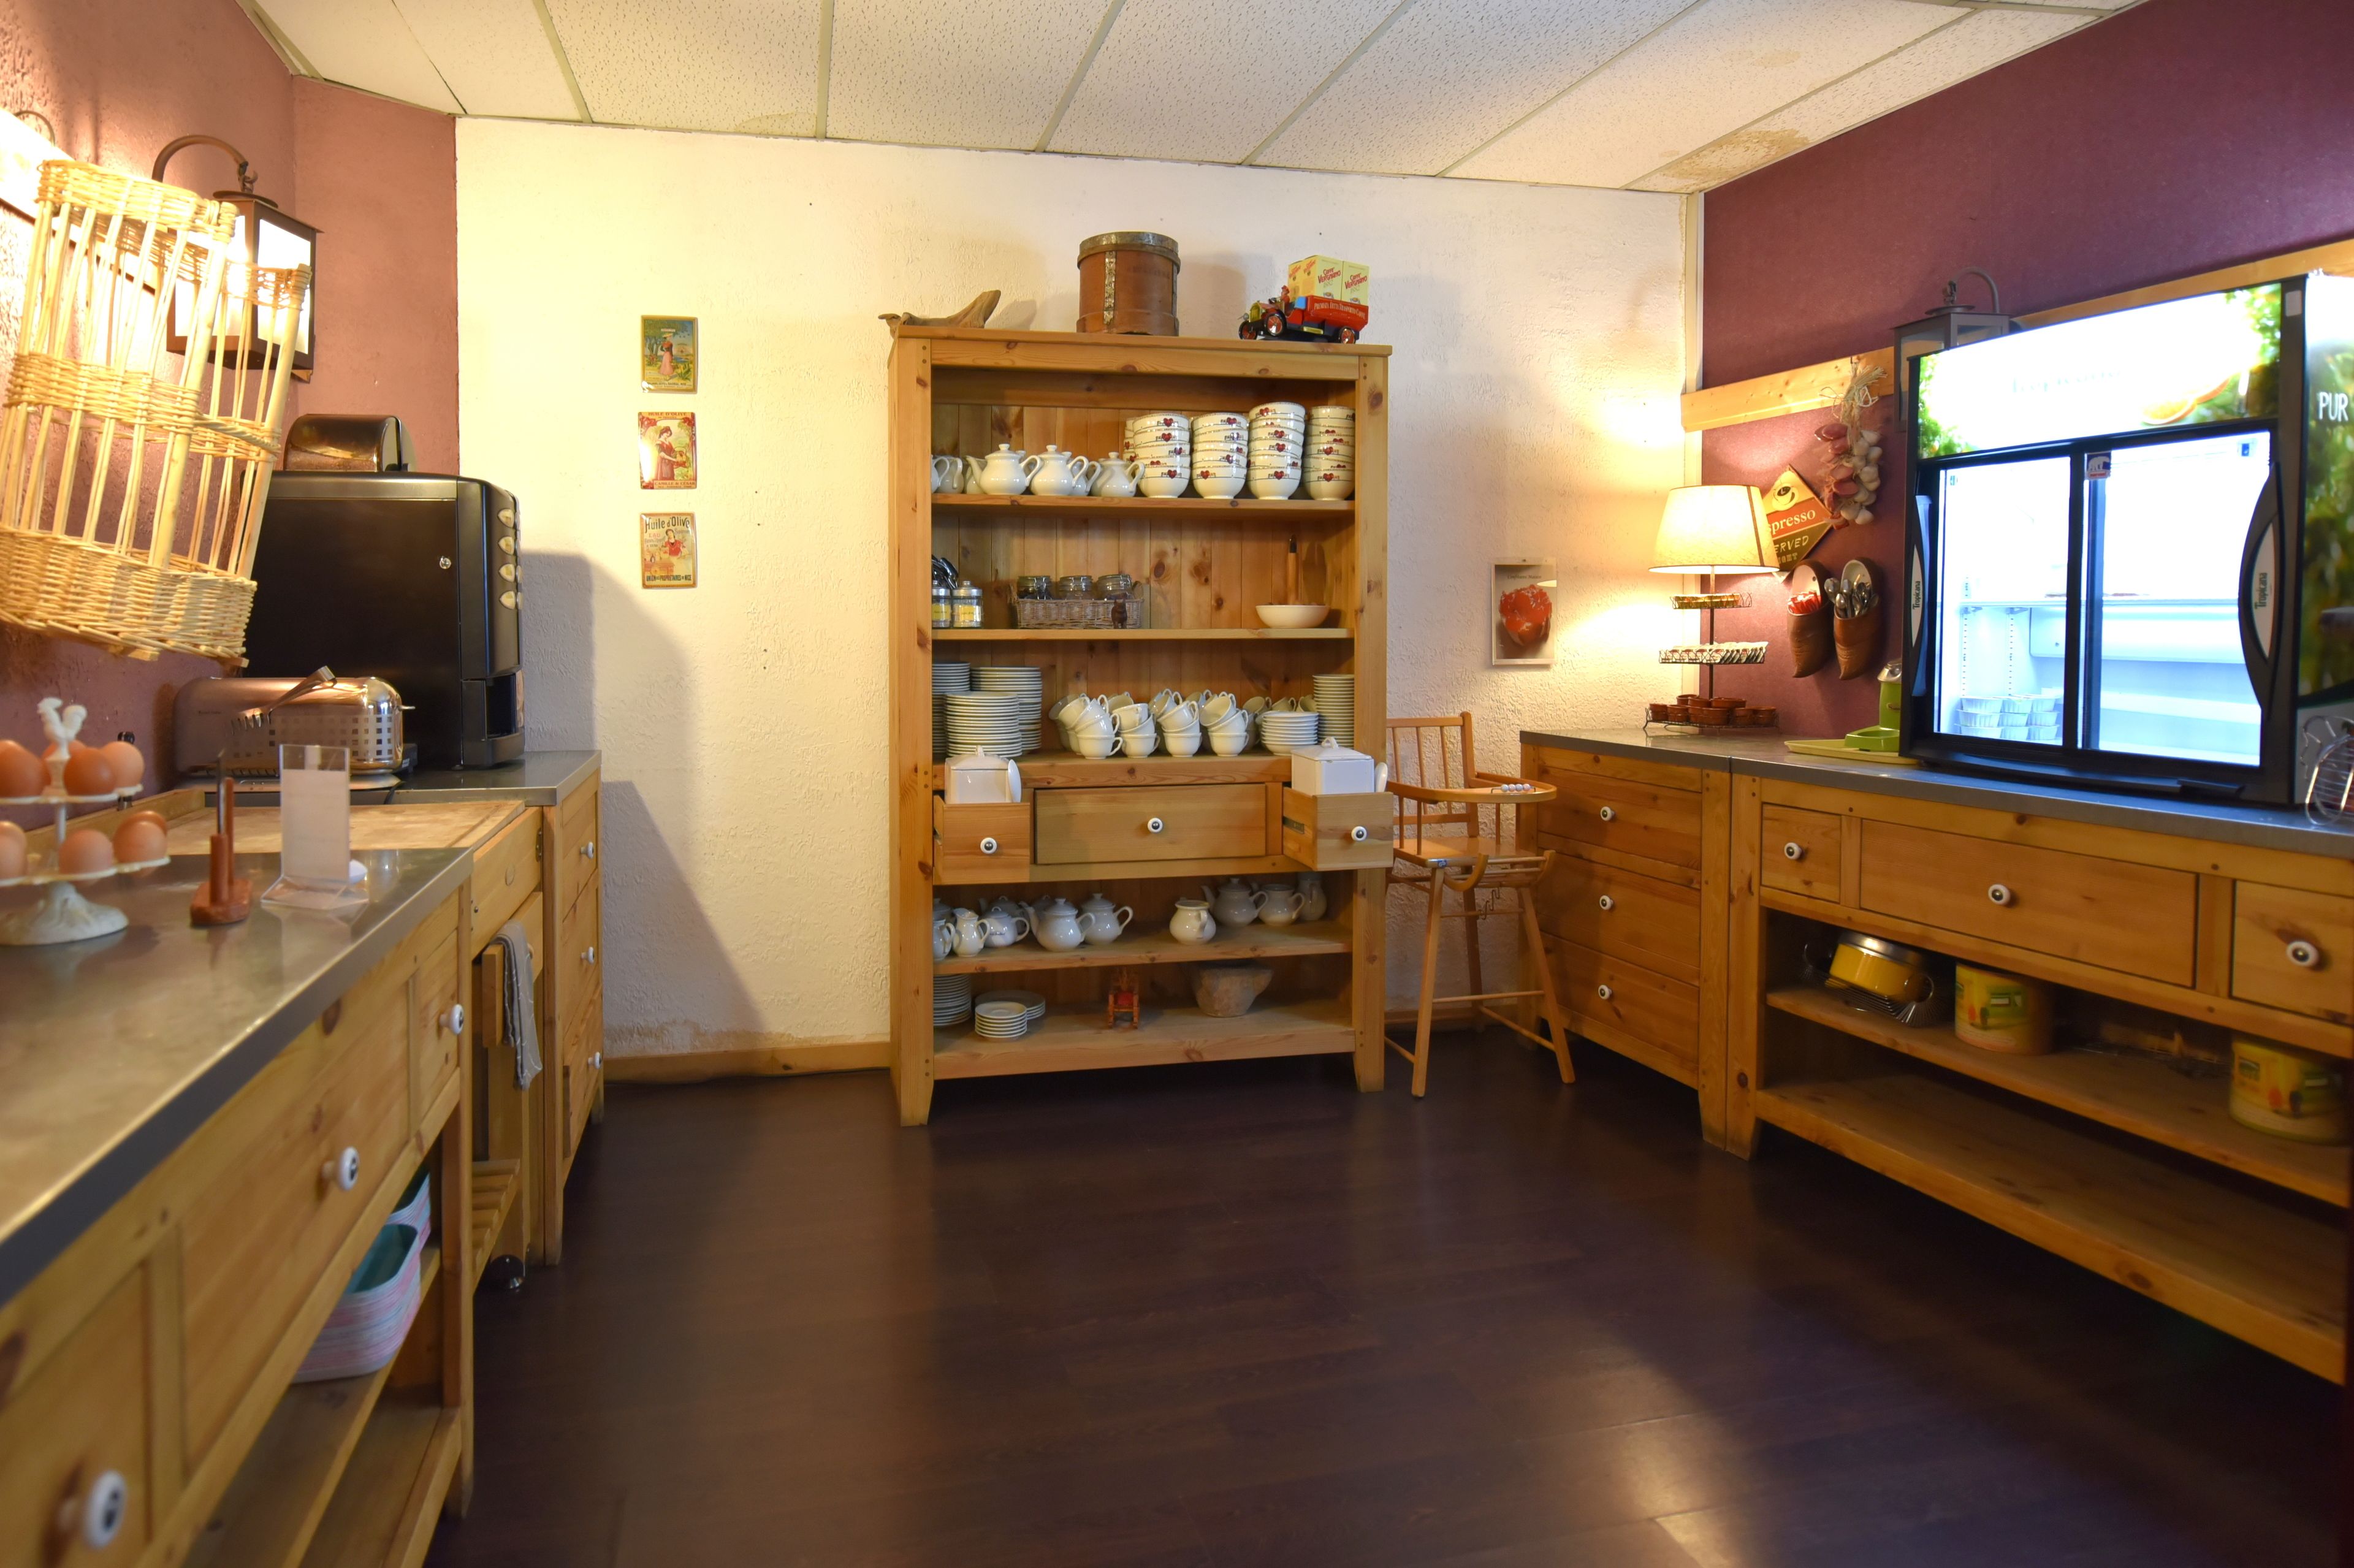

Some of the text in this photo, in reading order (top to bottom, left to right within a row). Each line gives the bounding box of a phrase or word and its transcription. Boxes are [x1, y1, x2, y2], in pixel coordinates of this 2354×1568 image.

[2319, 391, 2349, 422] PUR
[645, 516, 665, 533] Huile
[667, 516, 690, 529] d'Olive
[1912, 580, 1921, 610] Tropicana
[2254, 573, 2269, 609] Tropicana
